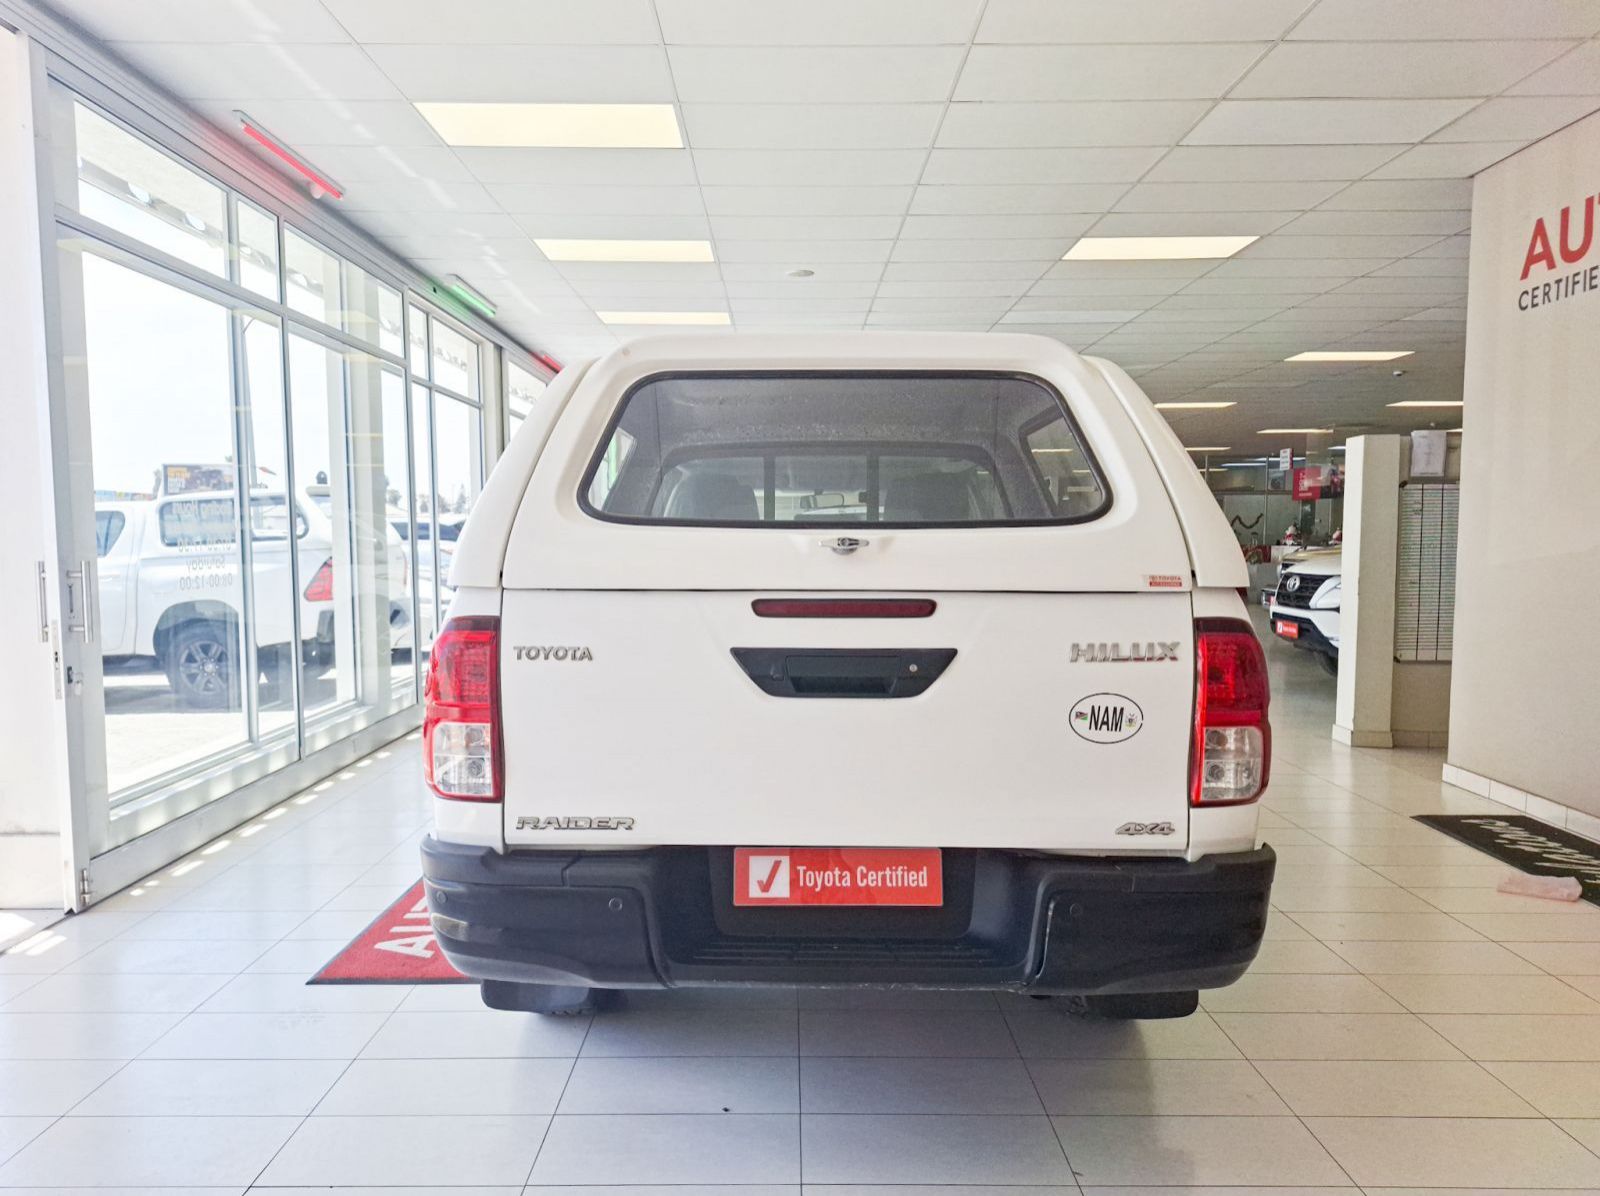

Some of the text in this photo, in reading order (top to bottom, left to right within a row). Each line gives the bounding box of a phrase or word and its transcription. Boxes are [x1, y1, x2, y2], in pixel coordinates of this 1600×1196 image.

[1519, 191, 1600, 281] AU
[1518, 265, 1600, 312] CERTIFIE
[513, 645, 594, 662] TOYOTA
[1069, 641, 1181, 663] HILUX
[1088, 704, 1125, 733] NAM
[515, 815, 635, 831] RAIDER
[796, 865, 928, 892] Toyota Certified
